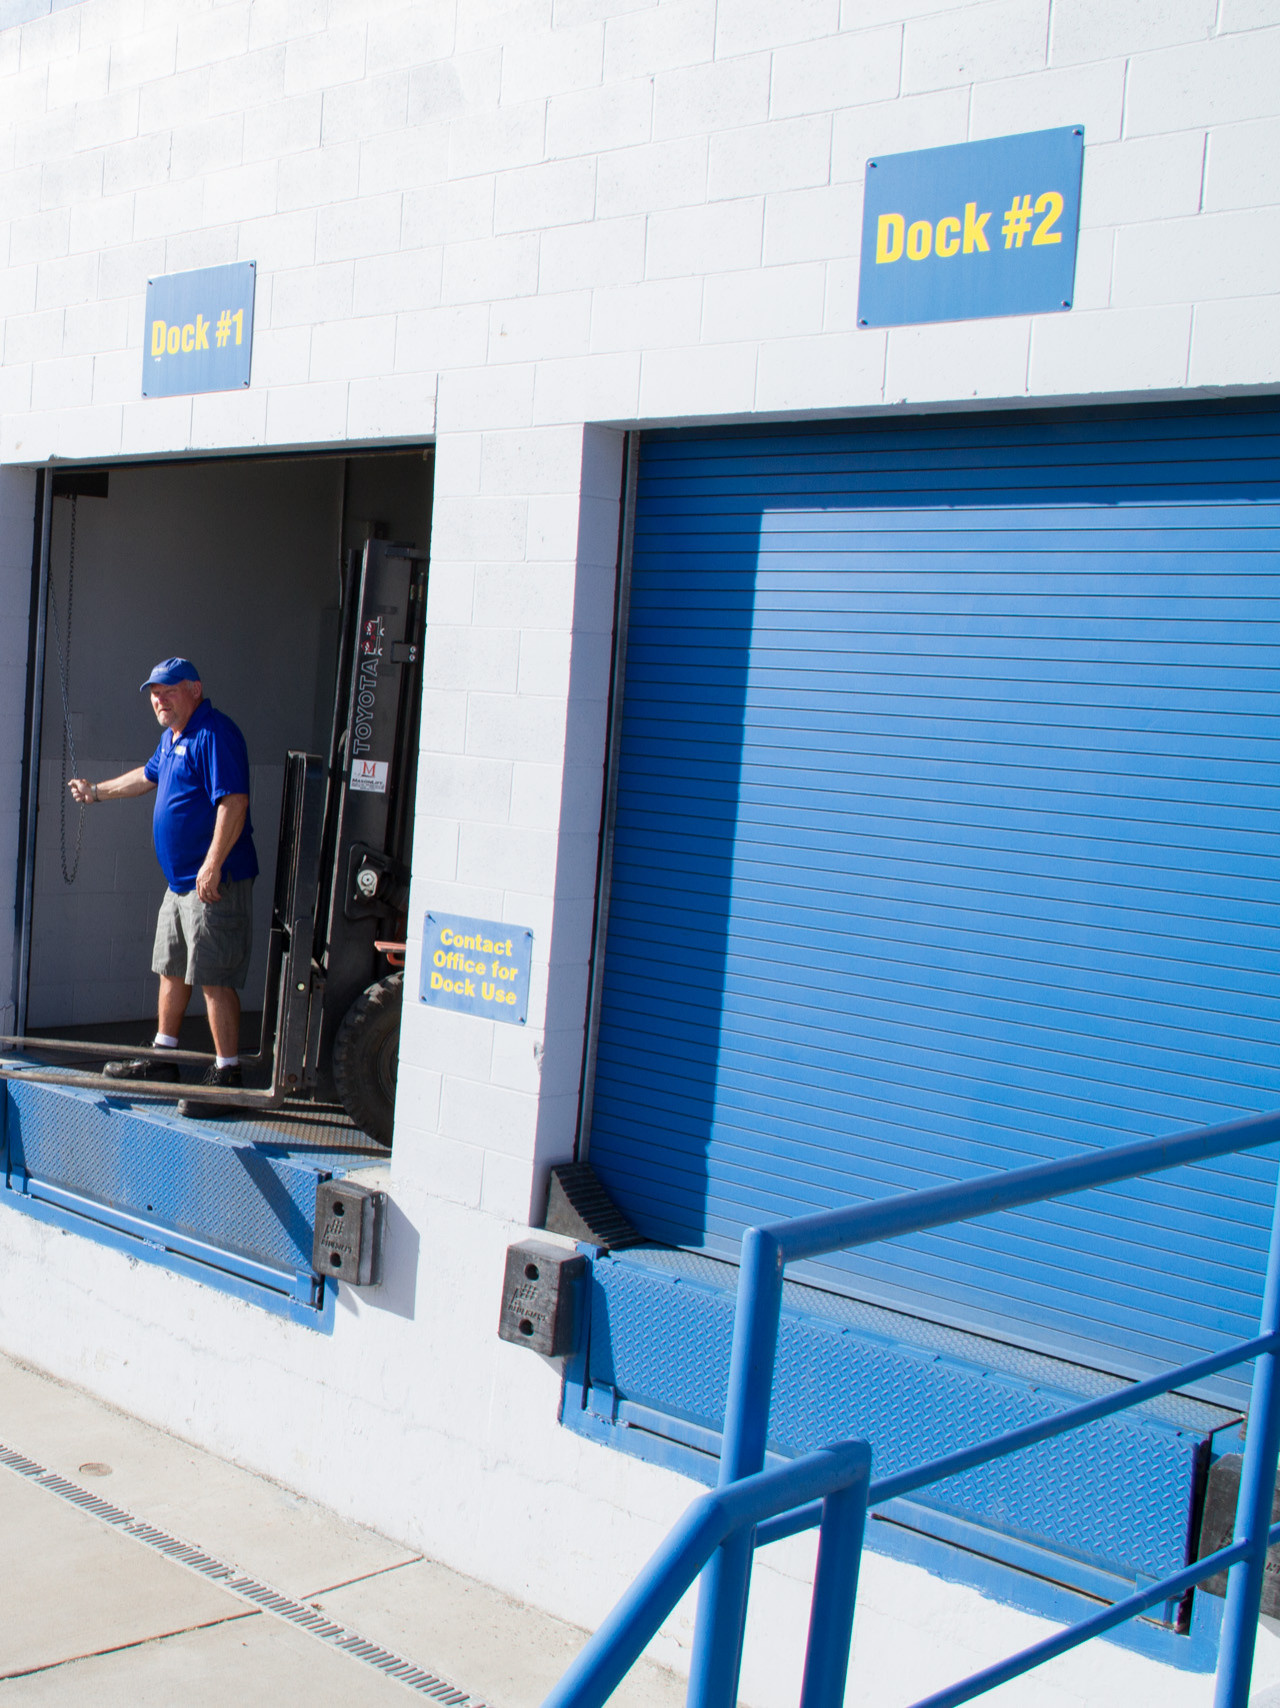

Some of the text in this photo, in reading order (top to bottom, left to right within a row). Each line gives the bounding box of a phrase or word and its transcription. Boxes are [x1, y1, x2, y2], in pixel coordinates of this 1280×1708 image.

[875, 191, 1064, 264] Dock #2
[151, 308, 243, 356] Dock #1
[353, 658, 379, 755] TOYOTA
[440, 928, 512, 957] Contact
[433, 950, 518, 981] Office for
[430, 972, 517, 1005] Dock Use
